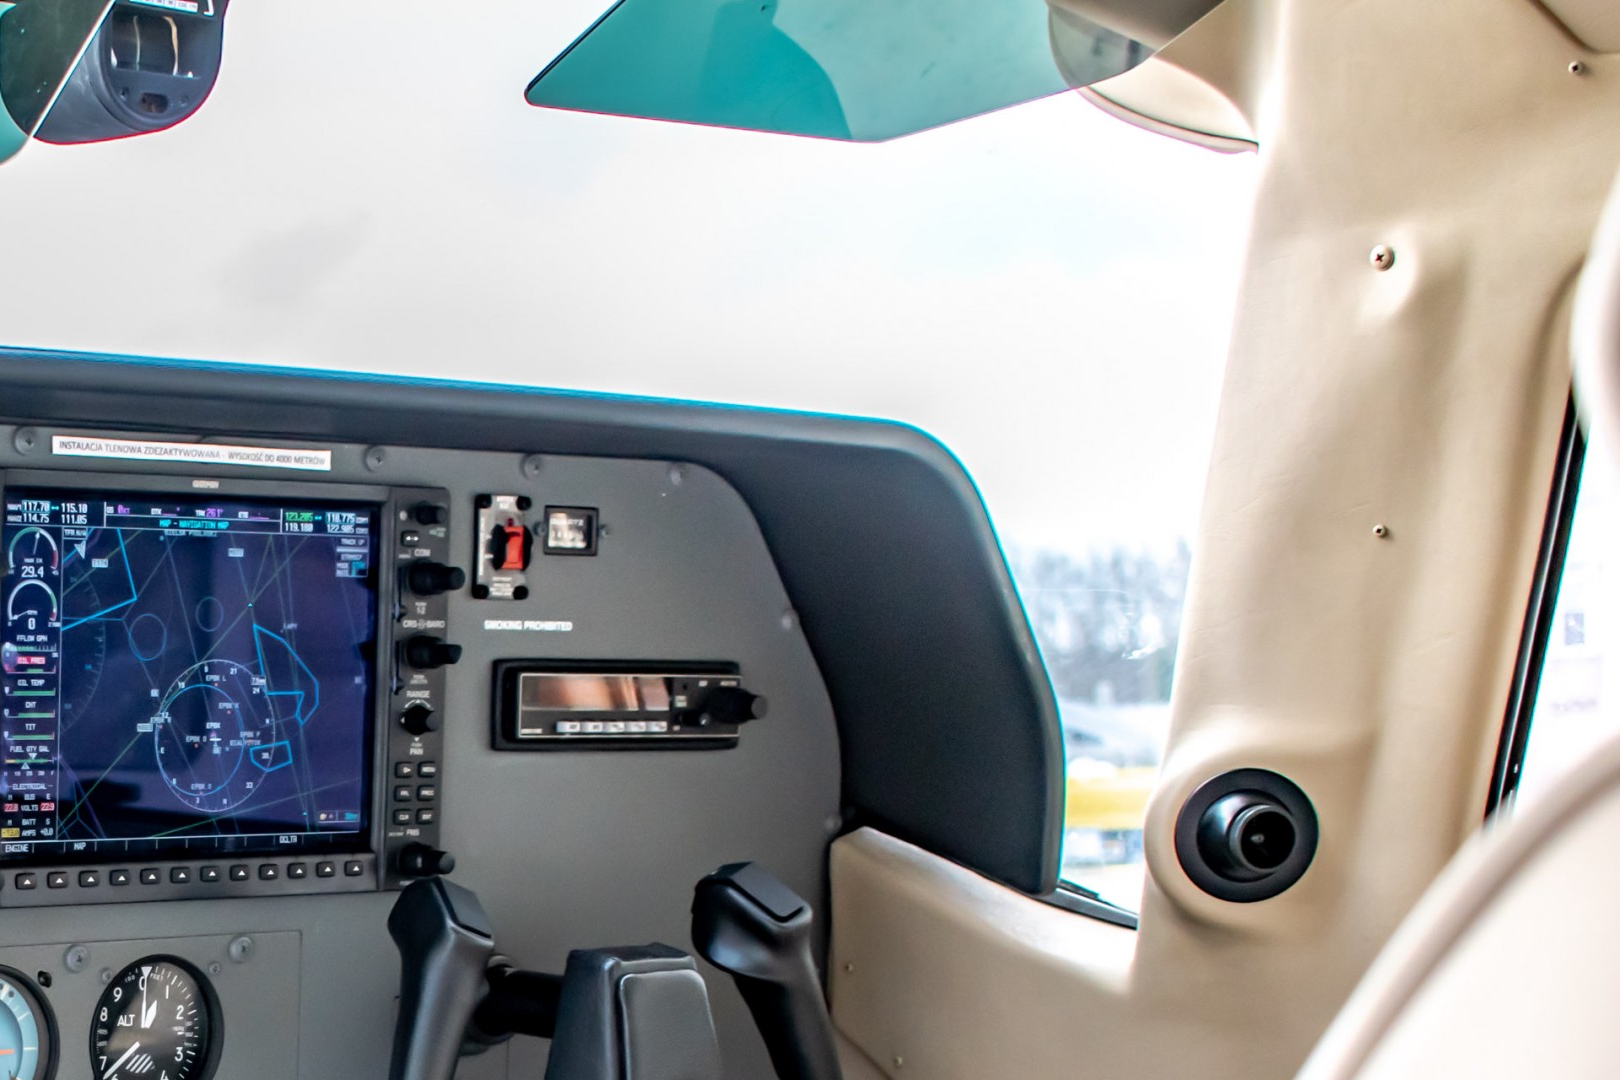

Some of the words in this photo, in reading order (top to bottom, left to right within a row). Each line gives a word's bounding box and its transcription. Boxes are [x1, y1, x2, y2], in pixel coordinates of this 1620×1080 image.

[59, 440, 103, 453] INSTALACJA
[105, 443, 142, 455] TLENOWA
[144, 446, 221, 459] ZDEZAKTYWOWANA
[265, 454, 274, 463] DO
[21, 566, 44, 578] 29.4
[5, 843, 29, 853] ENGINE
[113, 987, 123, 1002] 9
[99, 1007, 108, 1023] 8
[175, 1005, 184, 1021] 2
[117, 1014, 136, 1027] ALT
[174, 1047, 183, 1062] 3
[99, 1056, 108, 1071] 7
